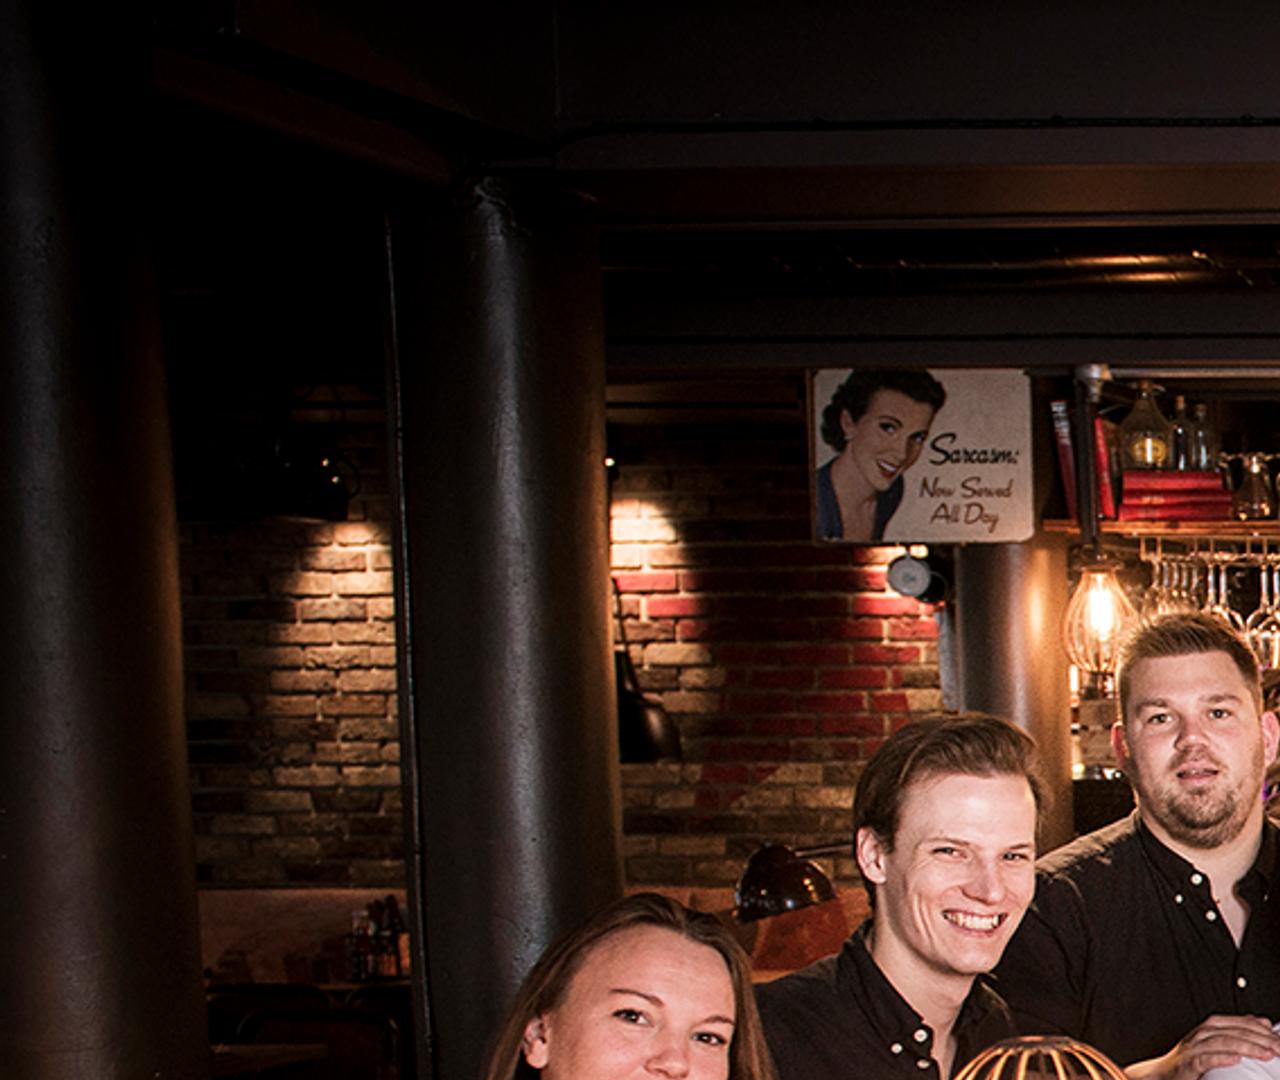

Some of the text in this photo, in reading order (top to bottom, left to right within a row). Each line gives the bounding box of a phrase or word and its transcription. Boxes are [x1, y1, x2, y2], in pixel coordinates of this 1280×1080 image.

[929, 432, 1020, 466] Sarcasm:
[919, 476, 1014, 499] Now Served
[930, 502, 1000, 534] All Day
